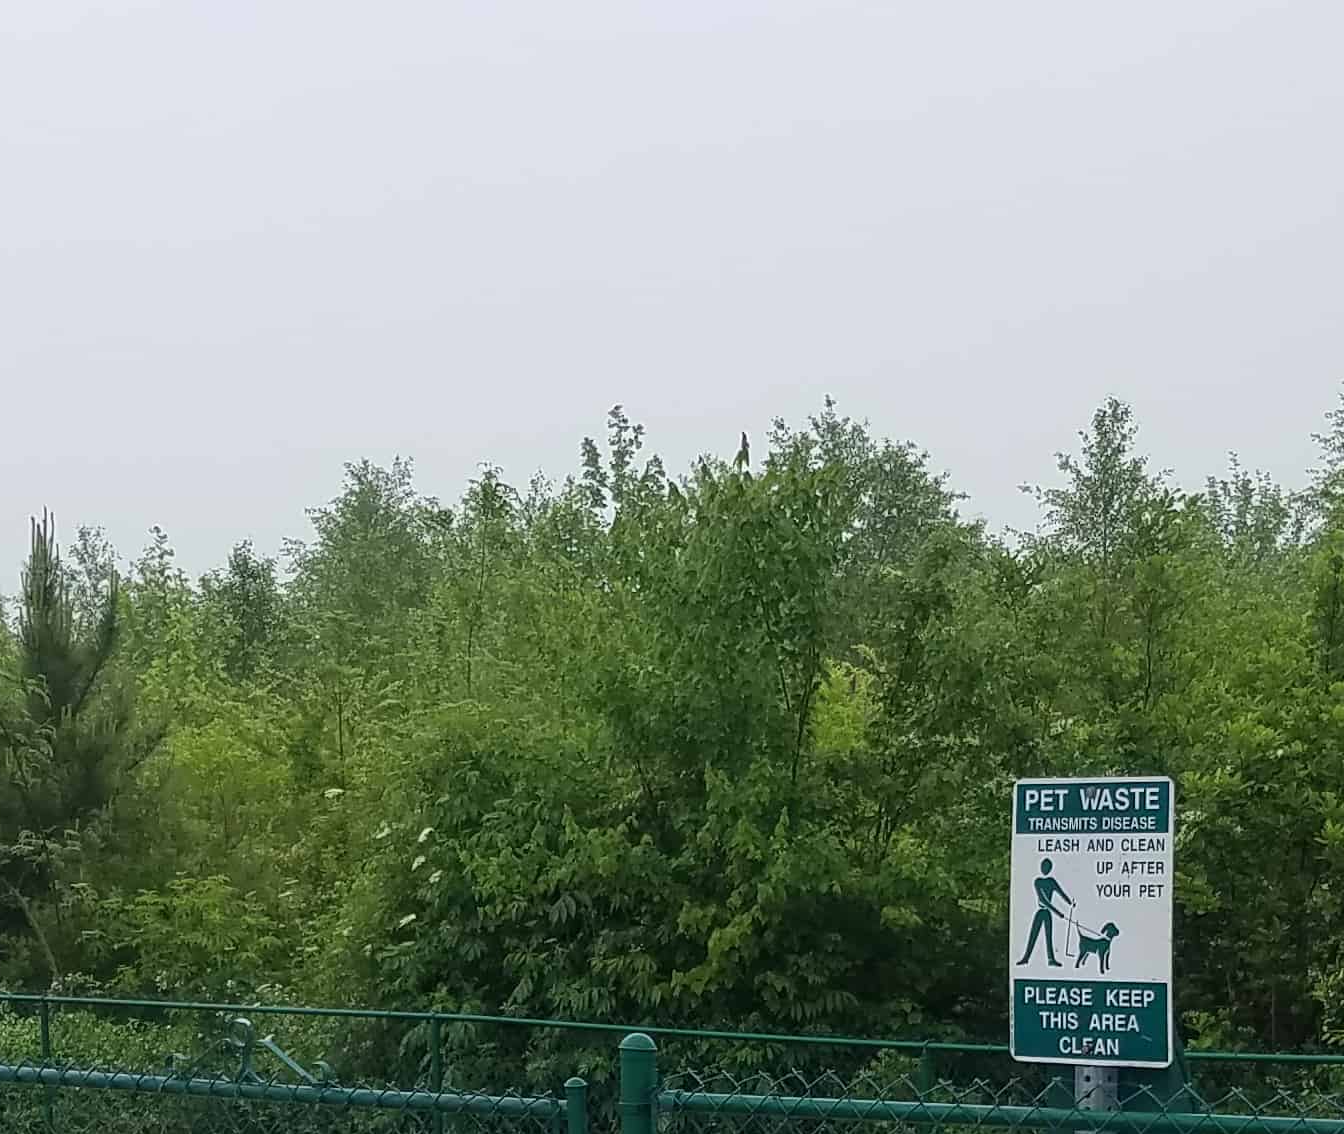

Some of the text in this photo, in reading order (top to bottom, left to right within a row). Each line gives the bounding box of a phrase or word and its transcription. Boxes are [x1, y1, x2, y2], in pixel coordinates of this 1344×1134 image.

[1025, 787, 1160, 811] PET WASTE
[1028, 816, 1156, 831] TRANSMITS DISEASE
[1038, 838, 1165, 852] LEASH AND CLEAN
[1096, 861, 1165, 874] UP AFTER
[1096, 884, 1164, 897] YOUR PET
[1024, 986, 1155, 1008] PLEASE KEEP
[1039, 1011, 1140, 1032] THIS AREA
